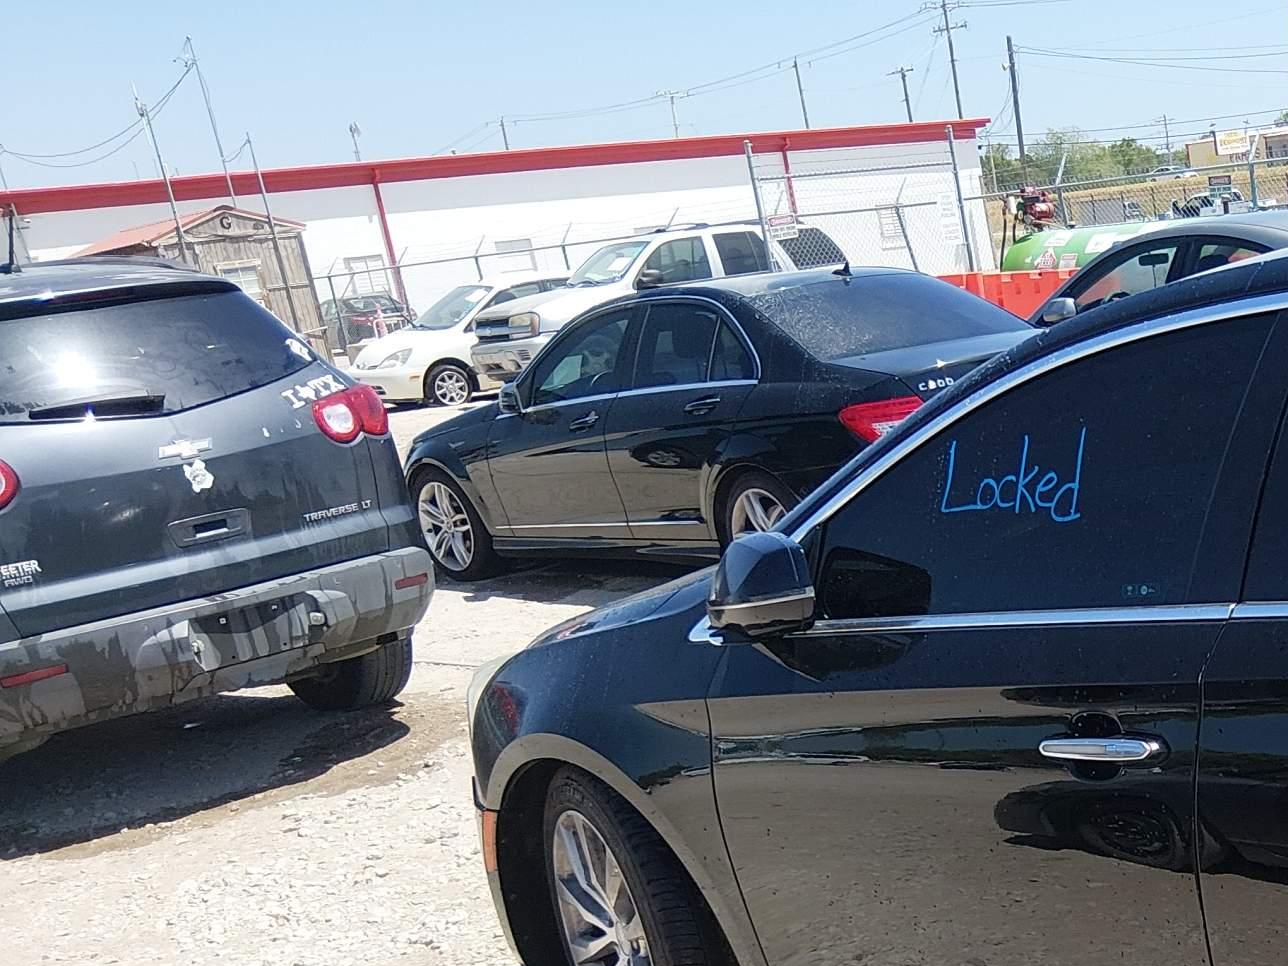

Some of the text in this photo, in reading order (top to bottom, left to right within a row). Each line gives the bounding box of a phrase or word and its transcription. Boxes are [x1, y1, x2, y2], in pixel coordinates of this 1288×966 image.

[220, 215, 232, 230] G
[941, 426, 1087, 522] Locked
[303, 499, 372, 522] TRAVERSE LT
